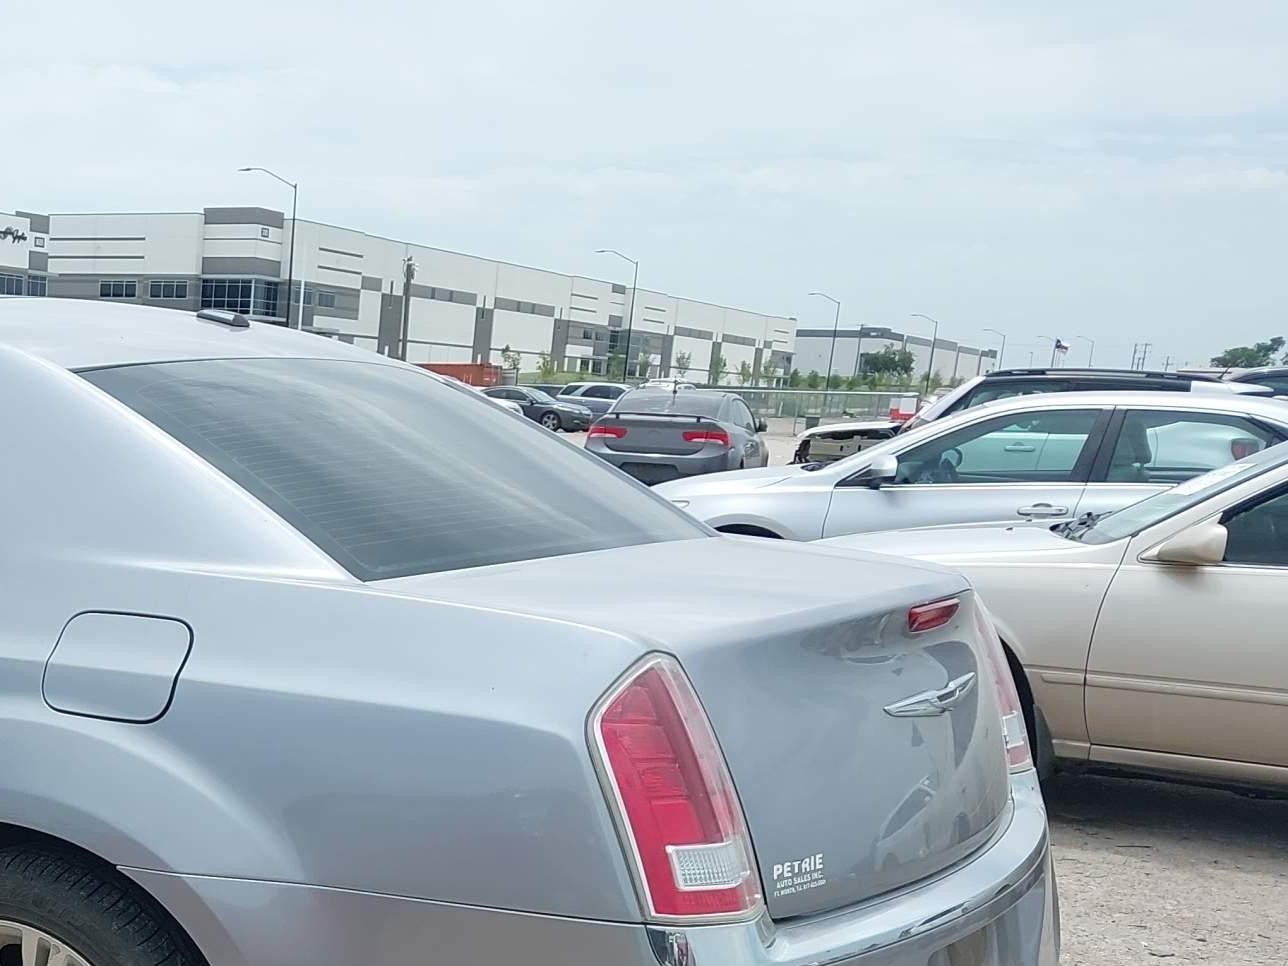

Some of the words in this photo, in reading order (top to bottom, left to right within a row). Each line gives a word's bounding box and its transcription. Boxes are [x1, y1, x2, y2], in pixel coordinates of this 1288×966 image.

[773, 853, 824, 881] PETRIE
[776, 878, 793, 889] AUTO
[793, 873, 811, 885] SALES
